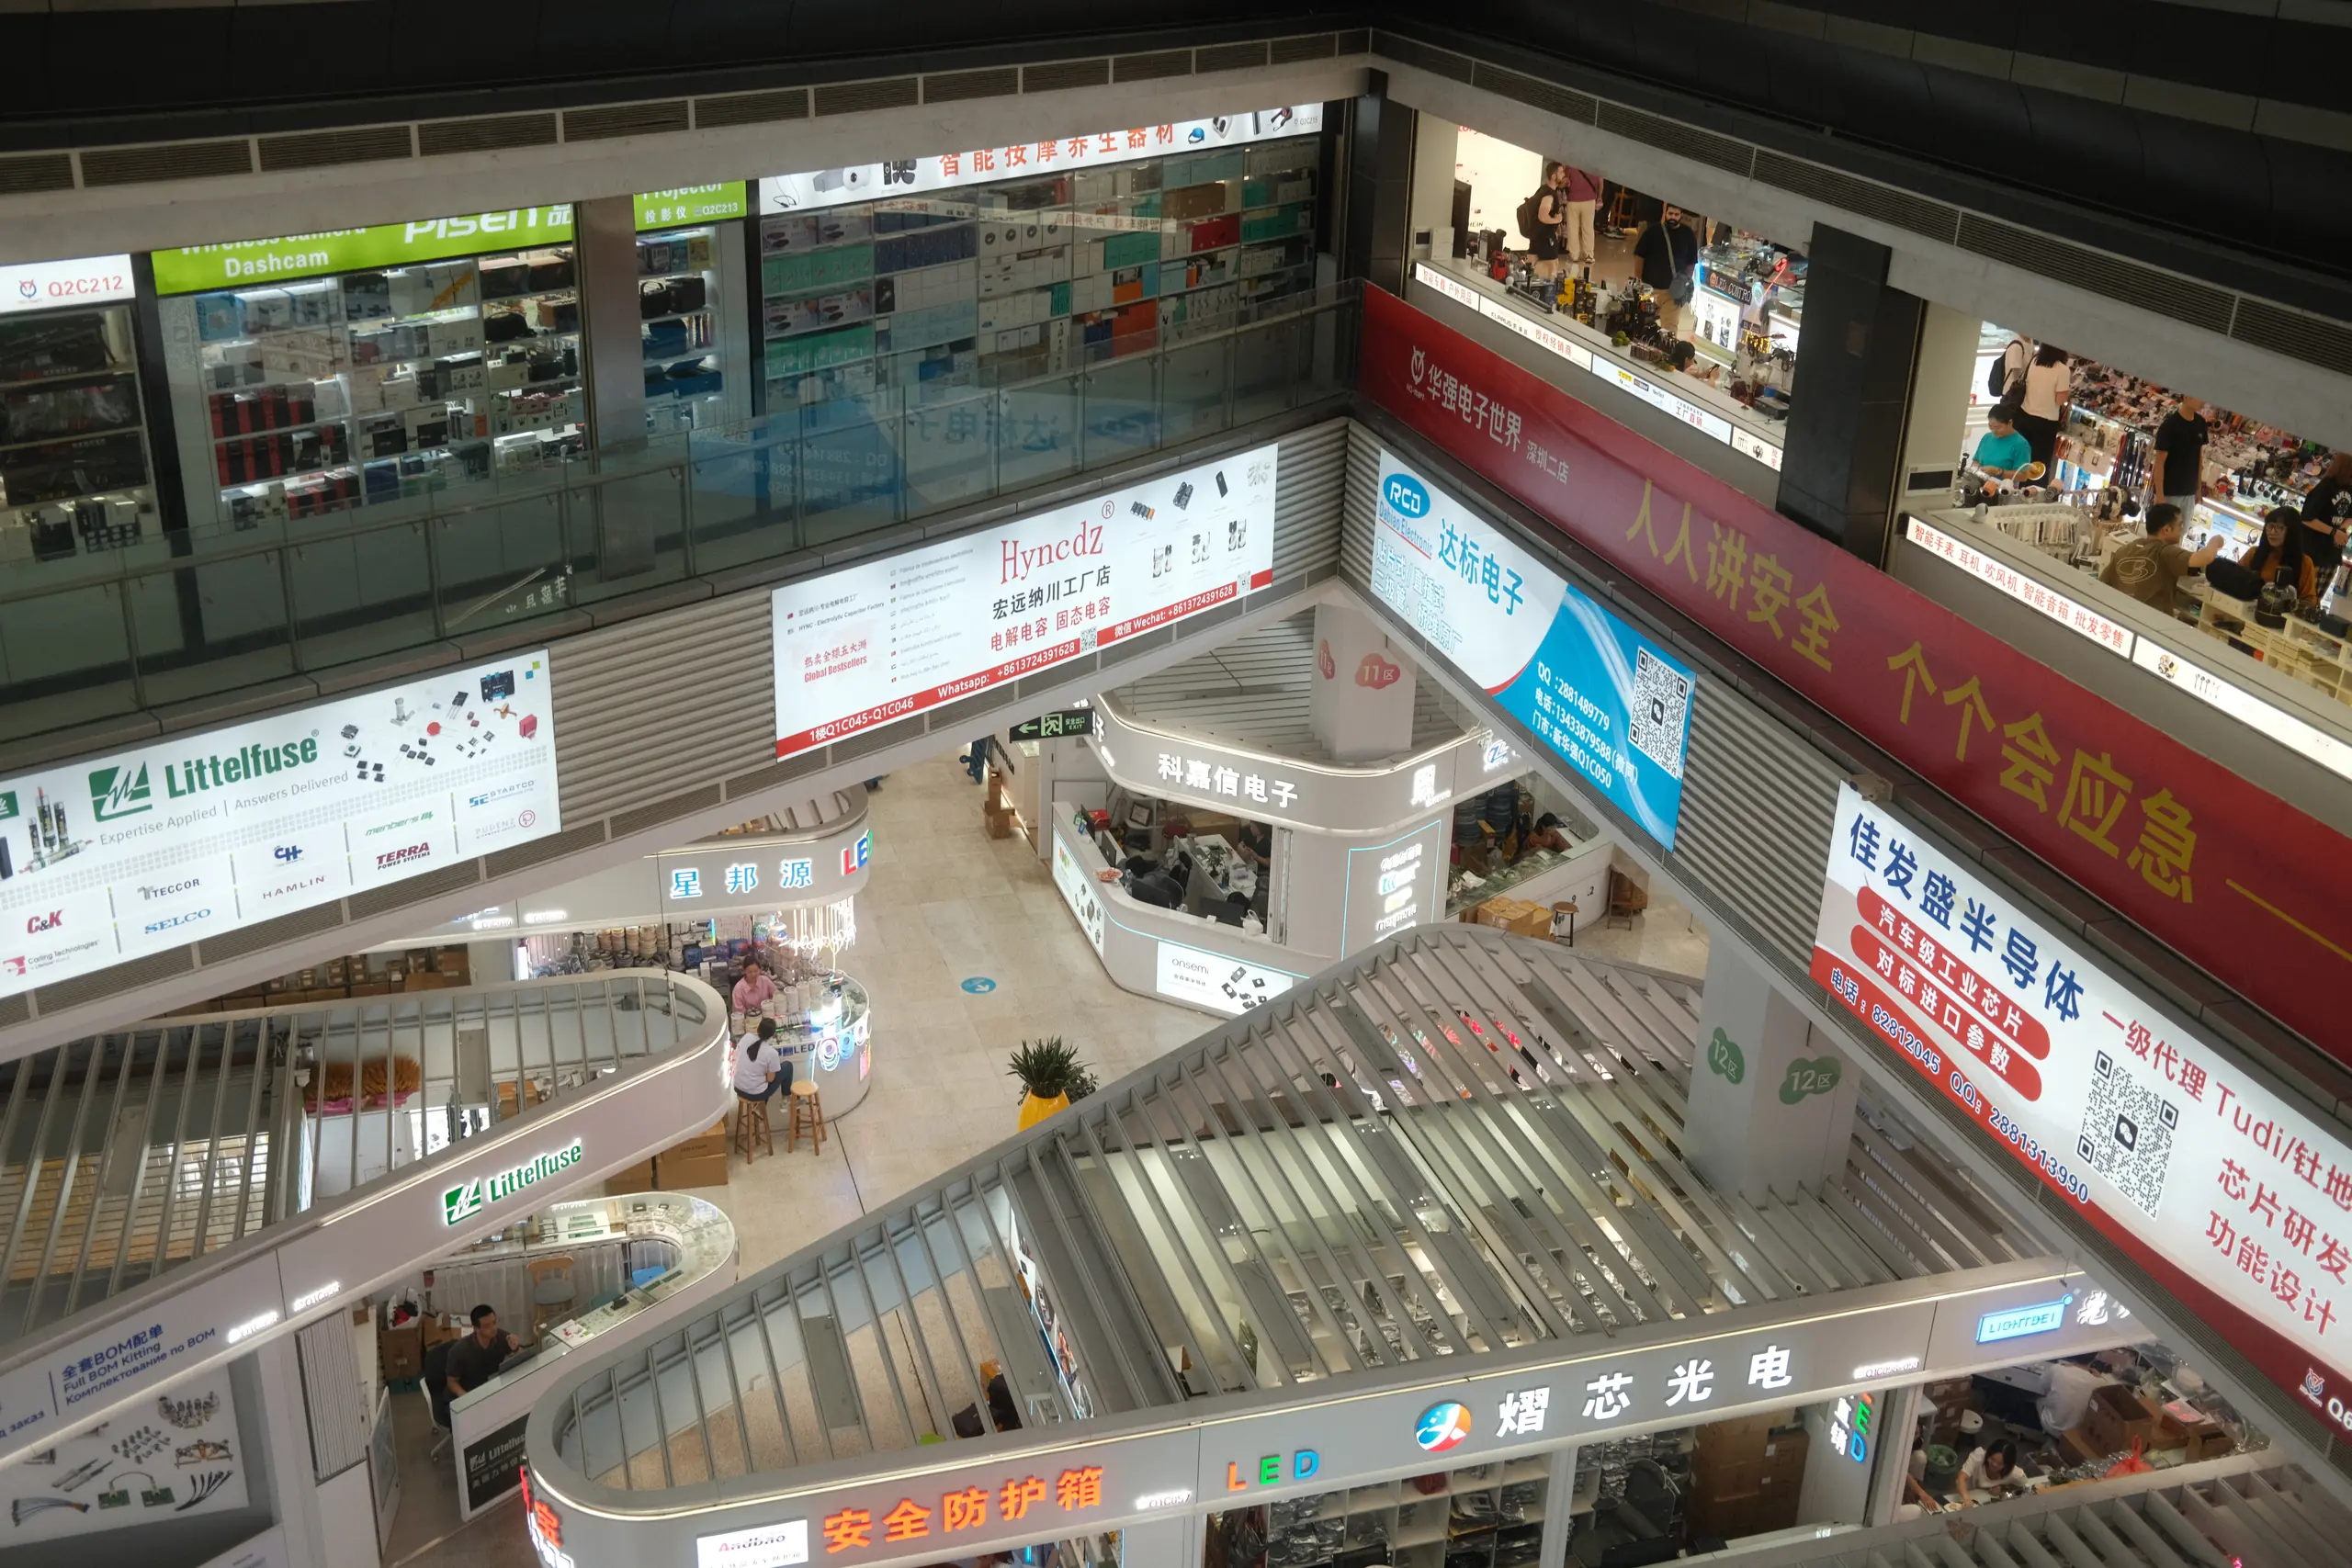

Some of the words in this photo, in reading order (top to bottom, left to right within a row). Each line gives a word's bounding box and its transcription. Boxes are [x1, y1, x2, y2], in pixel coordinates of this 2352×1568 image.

[645, 206, 686, 224] 投影仪
[703, 202, 739, 215] Q2C213
[48, 276, 123, 297] Q2C212
[224, 251, 329, 278] Dashcam
[1535, 329, 1572, 357] 授权经销商
[1427, 364, 1521, 453] 华强电子世界
[1526, 440, 1569, 486] 深圳二店
[1675, 406, 1702, 427] 工厂直销
[1389, 480, 1421, 514] RCD
[1001, 521, 1102, 584] Hyncdz
[1378, 502, 1400, 531] Dabiao
[1400, 518, 1433, 557] Electronic
[1438, 517, 1523, 615] 达标电子
[1914, 524, 1954, 558] 智能手表
[1959, 548, 1980, 573] 耳机
[1984, 564, 2018, 592] 吹风机
[2024, 581, 2070, 621] 智能音箱
[2075, 610, 2124, 649] 批发零售
[798, 623, 813, 632] HYNC
[817, 615, 843, 627] Electrolytic
[844, 606, 866, 620] Capacitor
[867, 602, 885, 613] Factory
[992, 565, 1111, 620] 宏远纳川工厂店
[1114, 621, 1131, 637] 微信
[1134, 610, 1166, 630] Wechat:
[1168, 584, 1233, 616] +8613724391628
[990, 616, 1047, 652] 电解电容
[1057, 596, 1111, 631] 固态电容
[804, 667, 827, 683] Global
[828, 656, 867, 676] Bestsellers
[809, 697, 914, 742] 1楼Q1C045-Q1C046
[938, 673, 990, 699] Whatsapp:
[997, 644, 1075, 678] +8613724391628
[1363, 664, 1395, 682] 11区
[1537, 661, 1551, 686] QQ
[1625, 478, 1840, 673] 人人讲安全
[1887, 641, 2197, 904] 个个会应急
[165, 738, 318, 799] Littelfuse
[491, 780, 535, 797] STARTCO
[1158, 753, 1298, 808] 科嘉信电子
[100, 820, 164, 845] Expertise
[167, 806, 217, 829] Applied
[235, 789, 288, 810] Answers
[291, 771, 349, 795] Delivered
[376, 842, 430, 865] TERRA
[378, 860, 401, 871] POWER
[403, 852, 430, 863] SYSTEMS
[841, 829, 874, 876] LED
[152, 878, 200, 898] TECCOR
[263, 875, 325, 899] HAMLIN
[670, 857, 813, 899] 星邦源
[28, 908, 64, 934] C&K
[144, 908, 211, 934] SELCO
[1850, 812, 2085, 1023] 佳发盛半导体
[28, 952, 53, 965] Carling
[53, 941, 99, 957] Technologies
[1171, 957, 1210, 975] onsemi
[1879, 904, 2023, 1037] 汽车级工业芯片
[1876, 947, 2010, 1075] 对标进口参数
[793, 1043, 816, 1055] LED
[1713, 1038, 1738, 1079] 12区
[2101, 1010, 2208, 1103] 一级代理
[1791, 1069, 1833, 1092] 12区
[1872, 1005, 1940, 1074] 82812045
[1988, 1106, 2089, 1203] 2881313990
[490, 1145, 582, 1202] Littelfuse
[2218, 1157, 2352, 1285] 芯片研发
[2205, 1210, 2338, 1337] 功能设计
[62, 1324, 164, 1382] 全套BOM配单
[63, 1377, 86, 1393] Full
[88, 1361, 119, 1382] BOM
[122, 1342, 162, 1366] Kitting
[66, 1352, 167, 1406] Комплектование
[171, 1345, 185, 1356] по
[1496, 1346, 1793, 1438] 熠芯光电
[9, 1410, 45, 1433] заказ
[1227, 1449, 1319, 1492] LED
[823, 1466, 1103, 1554] 安全防护箱
